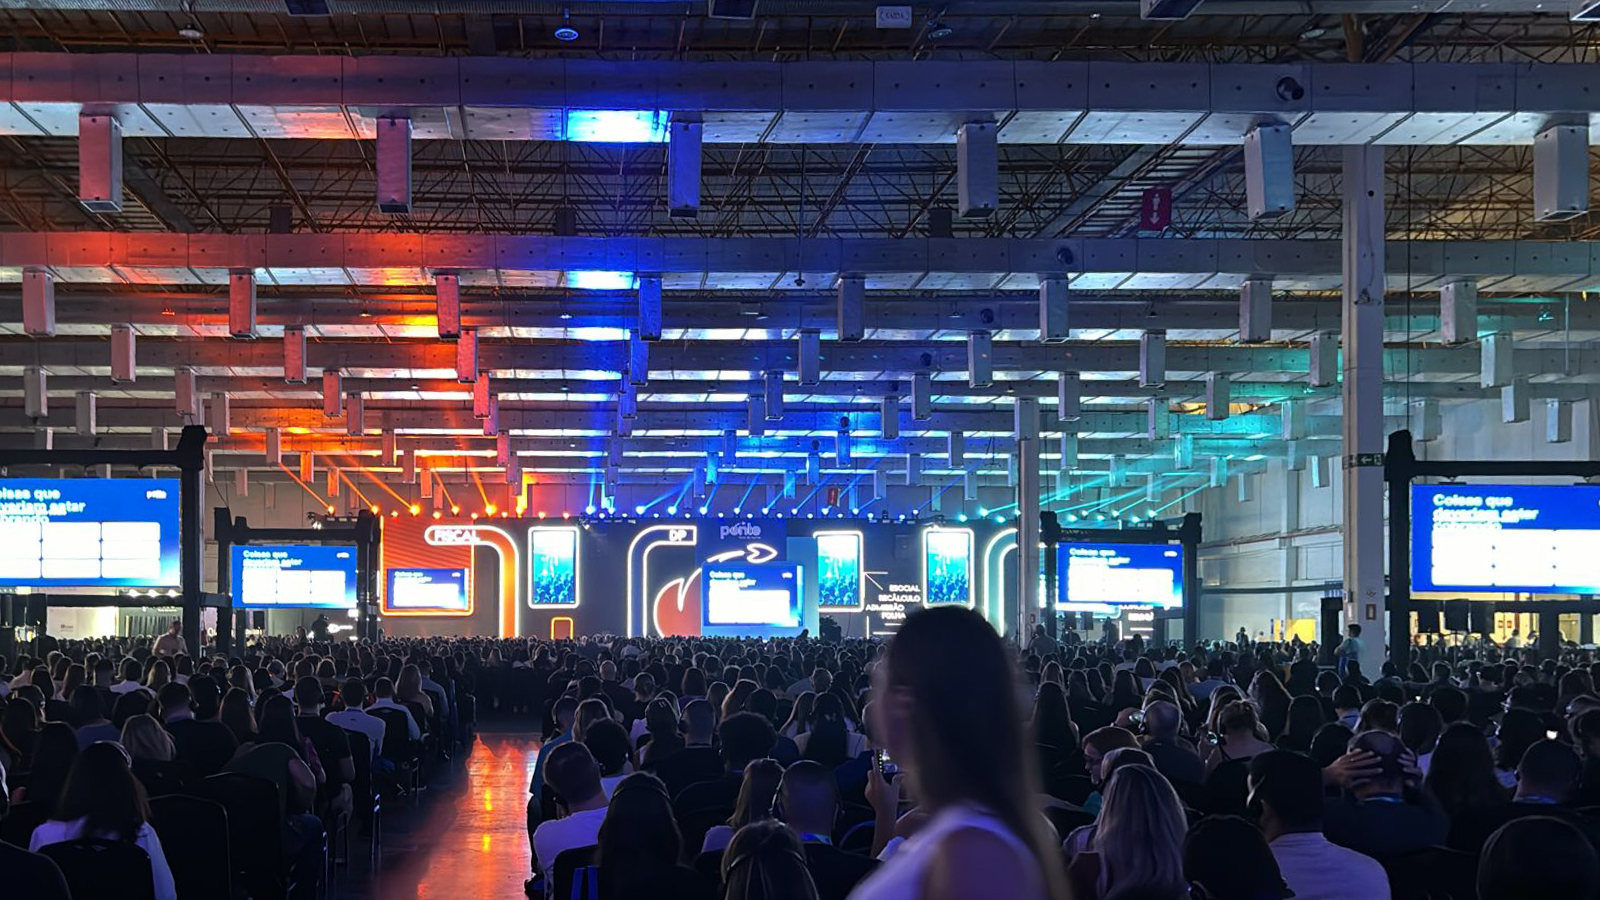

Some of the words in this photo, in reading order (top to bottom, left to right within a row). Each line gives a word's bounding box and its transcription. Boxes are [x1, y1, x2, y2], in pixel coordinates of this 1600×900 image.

[34, 489, 60, 501] que
[434, 528, 481, 543] FISCAL
[669, 529, 687, 541] DP
